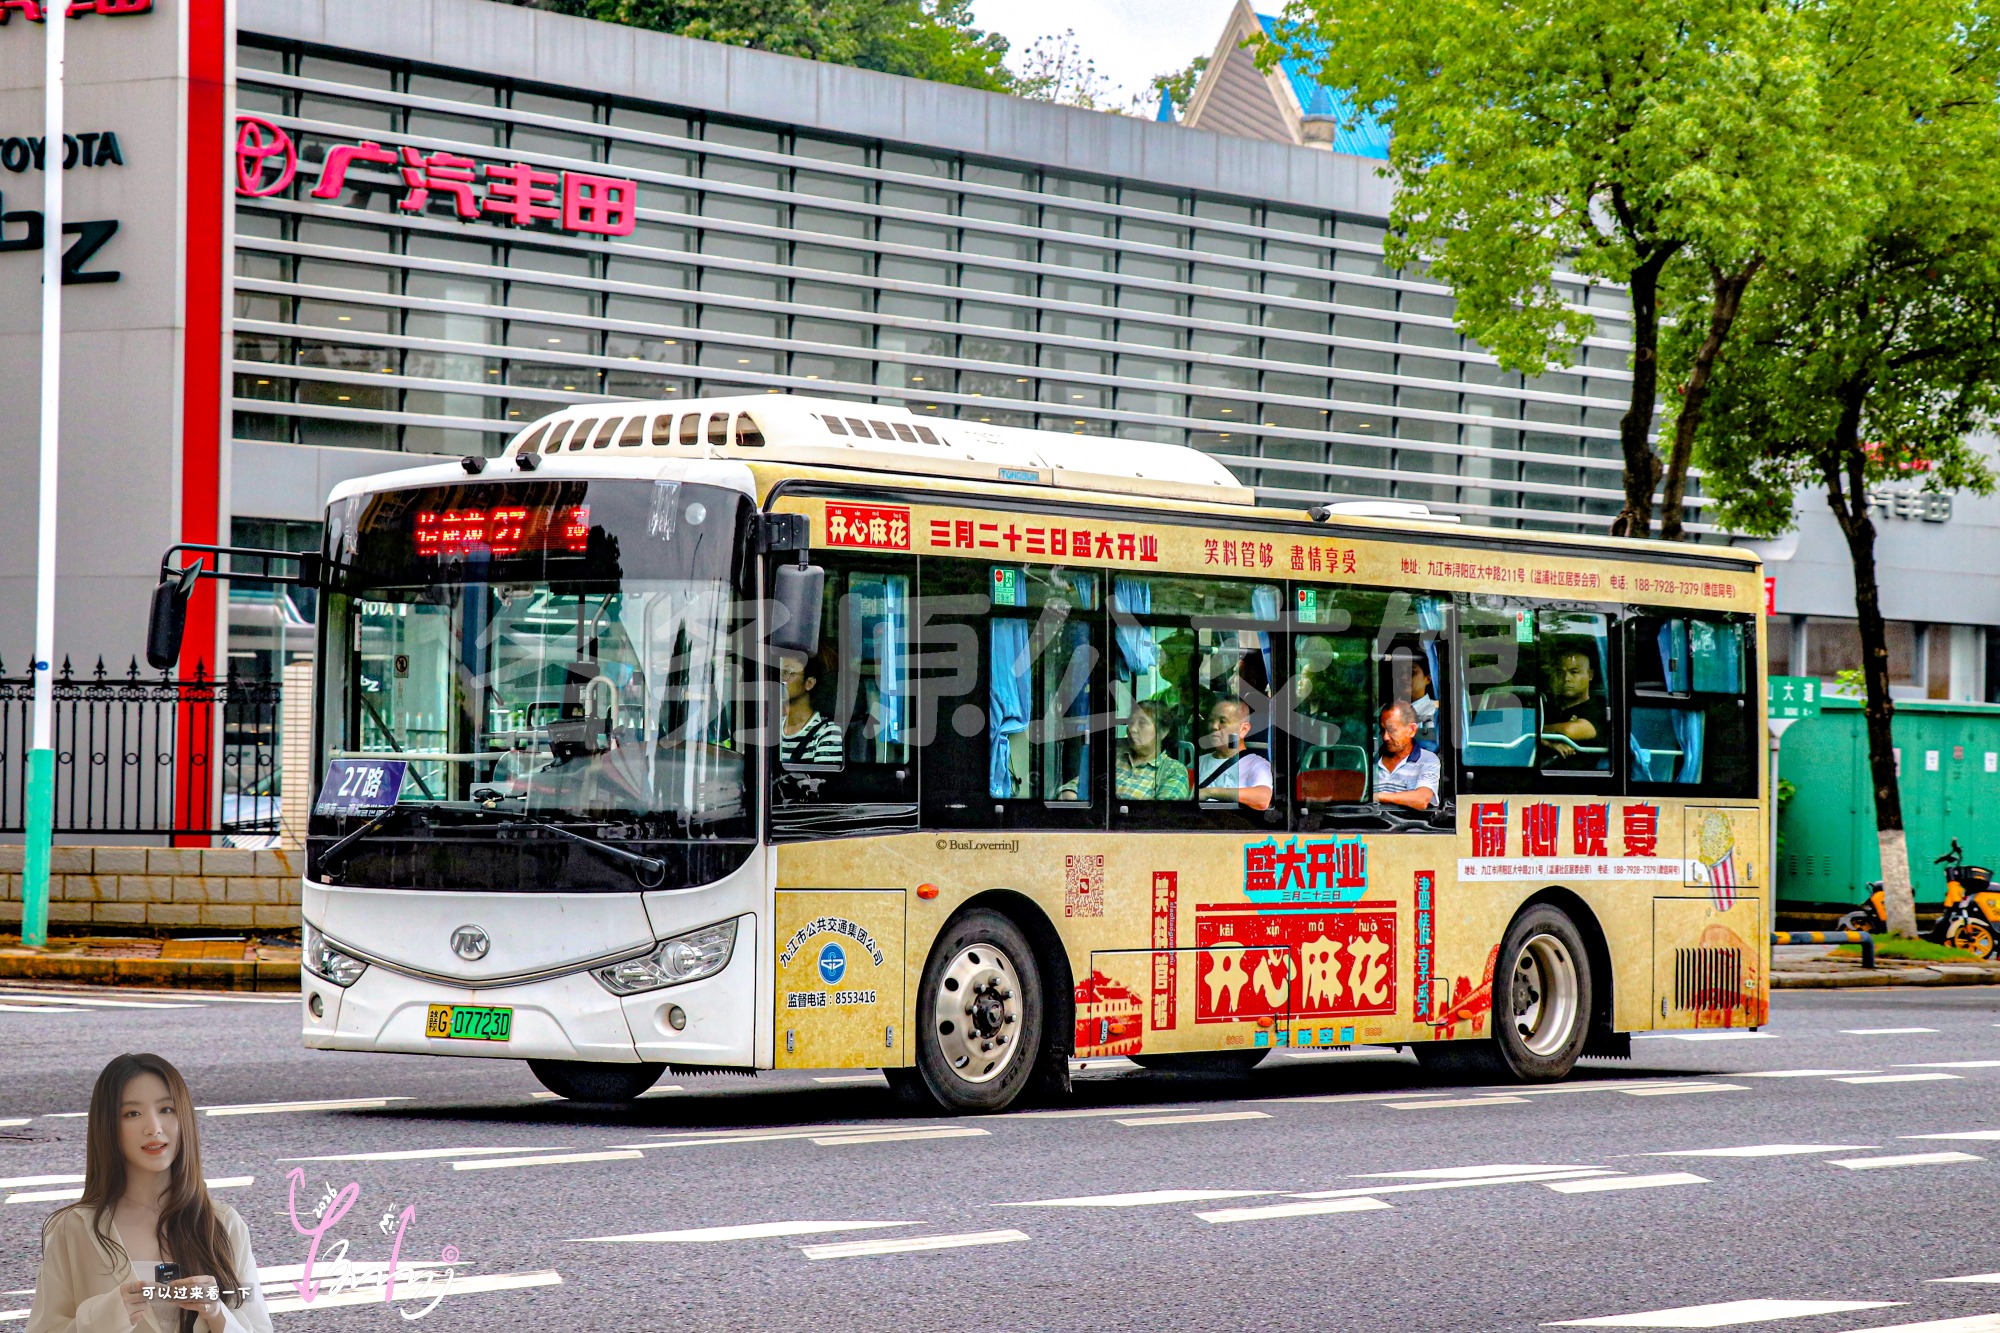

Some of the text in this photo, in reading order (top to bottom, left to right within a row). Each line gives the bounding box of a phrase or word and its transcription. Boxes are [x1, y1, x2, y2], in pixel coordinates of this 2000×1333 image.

[0, 131, 123, 173] OYOTA
[310, 140, 637, 237] 广汽丰田
[829, 515, 907, 547] 开心麻花
[930, 519, 1158, 562] 三月二十三日盛大开业
[1204, 538, 1356, 574] 笑料管够 盡情享受
[337, 766, 384, 798] 27路
[1245, 840, 1366, 891] 盛大开业
[1282, 890, 1341, 901] 三月二十三日
[779, 917, 884, 967] 九江市公共交通集团公司
[1204, 935, 1390, 1013] 开心麻花
